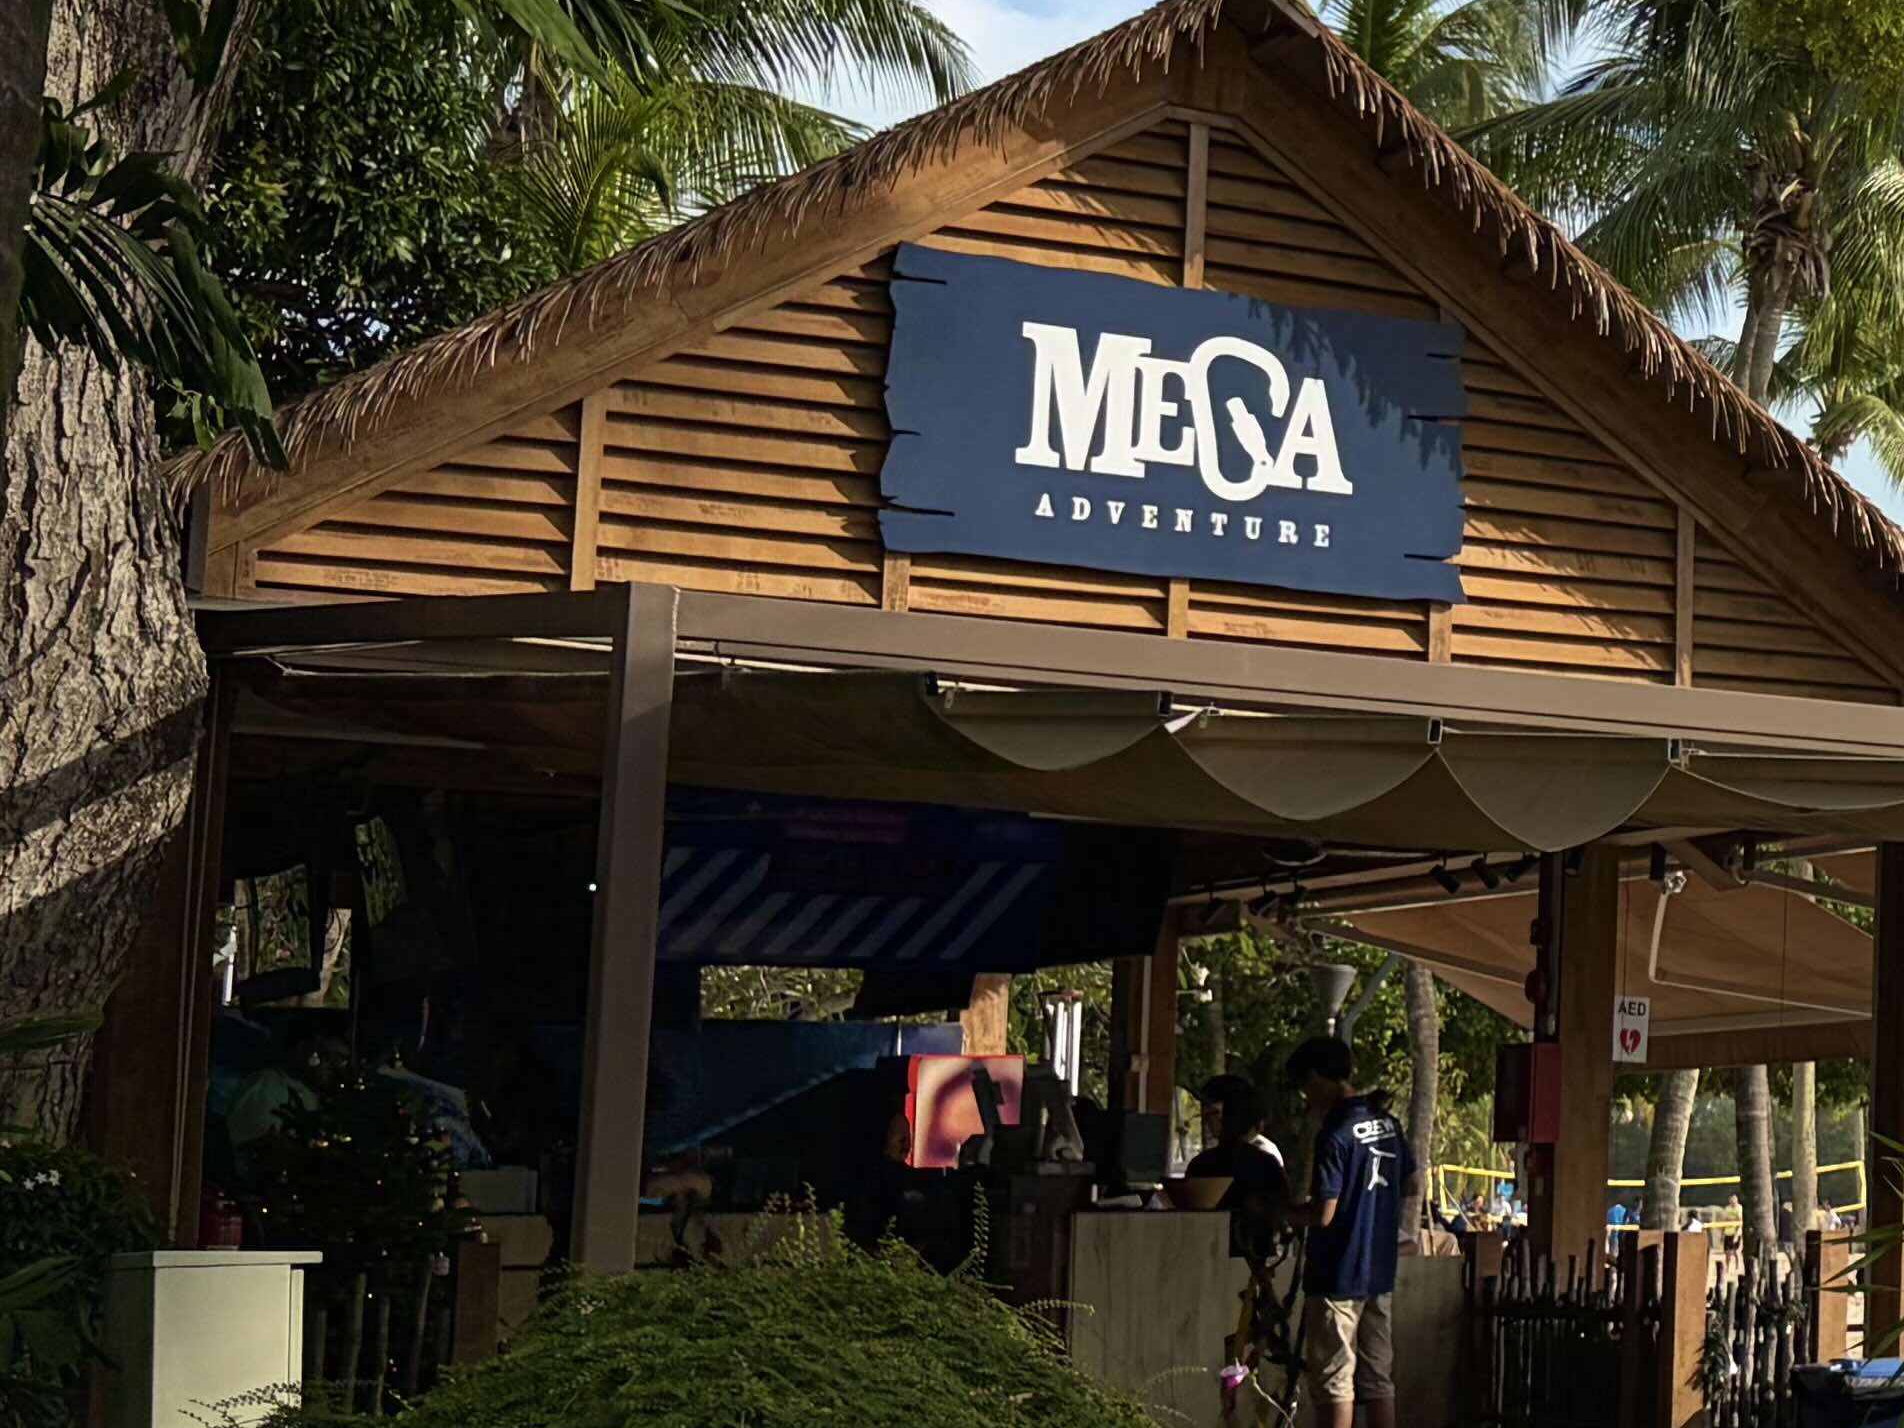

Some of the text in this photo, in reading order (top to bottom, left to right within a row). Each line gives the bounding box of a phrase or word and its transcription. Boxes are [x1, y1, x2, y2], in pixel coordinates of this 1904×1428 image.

[1015, 321, 1353, 502] MEGA
[1034, 492, 1331, 549] ADVENTURE
[1618, 1001, 1646, 1017] AED
[1353, 1119, 1395, 1139] CREW
